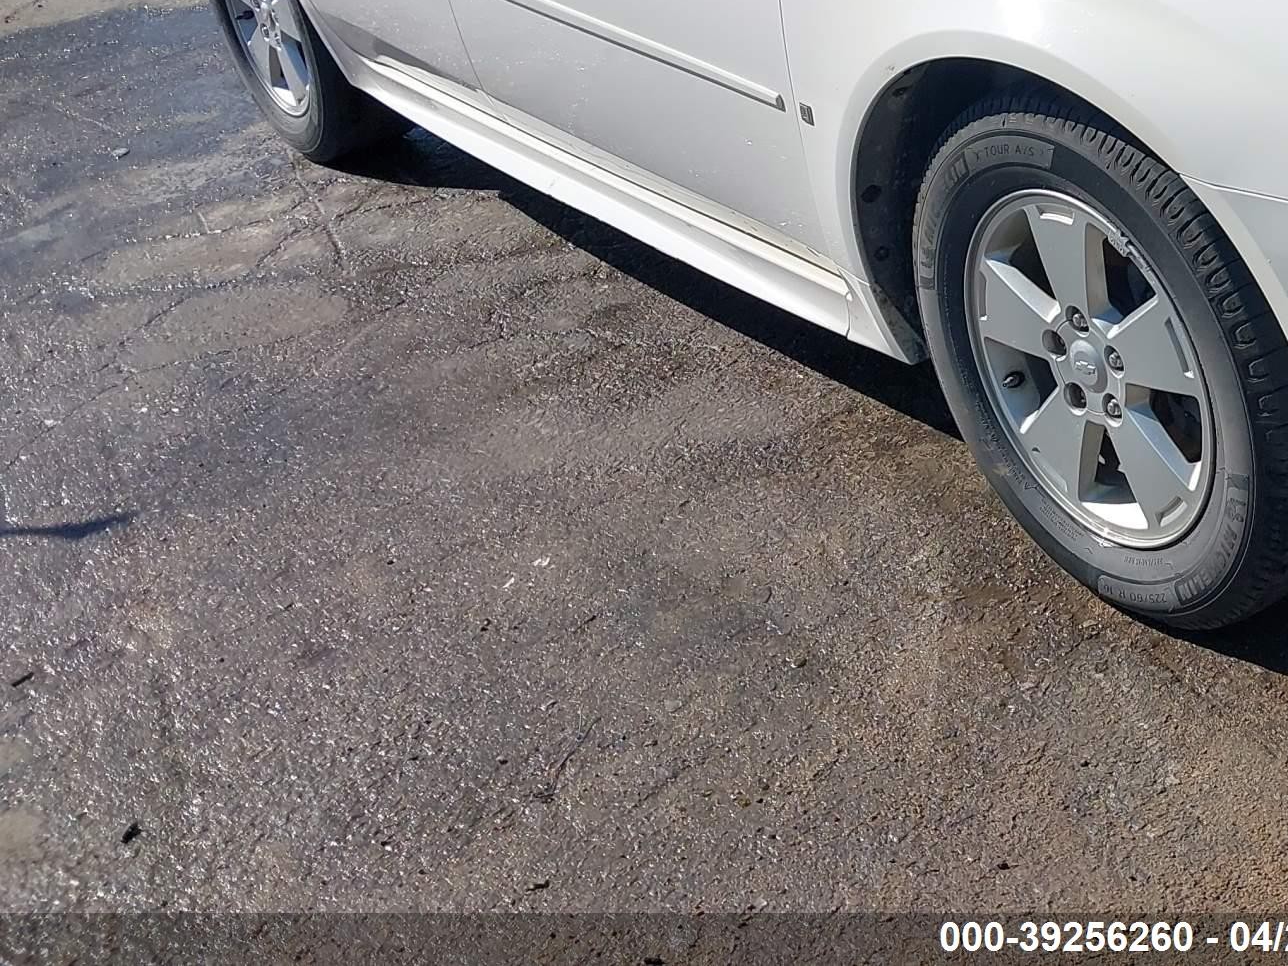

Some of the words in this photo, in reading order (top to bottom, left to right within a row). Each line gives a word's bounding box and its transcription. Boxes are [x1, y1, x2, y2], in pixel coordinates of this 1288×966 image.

[984, 144, 1010, 156] TOUR
[1015, 144, 1034, 156] A/S
[1129, 592, 1167, 603] 225/60
